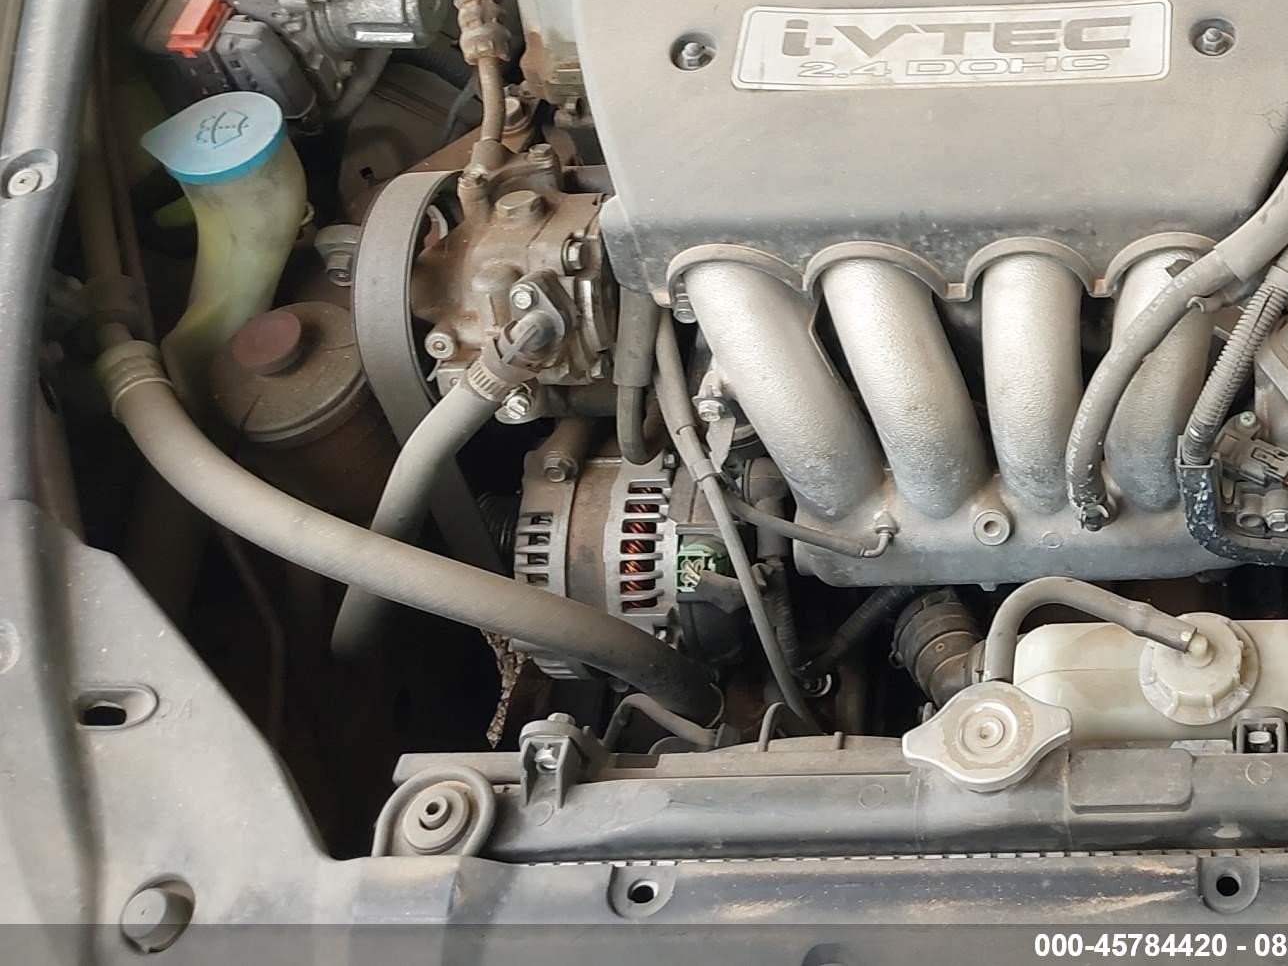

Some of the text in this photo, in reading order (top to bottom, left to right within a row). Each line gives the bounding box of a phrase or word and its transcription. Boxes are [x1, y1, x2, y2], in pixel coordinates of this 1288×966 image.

[781, 16, 1132, 59] i-VTEC
[798, 54, 1110, 79] 2.4 DOHC
